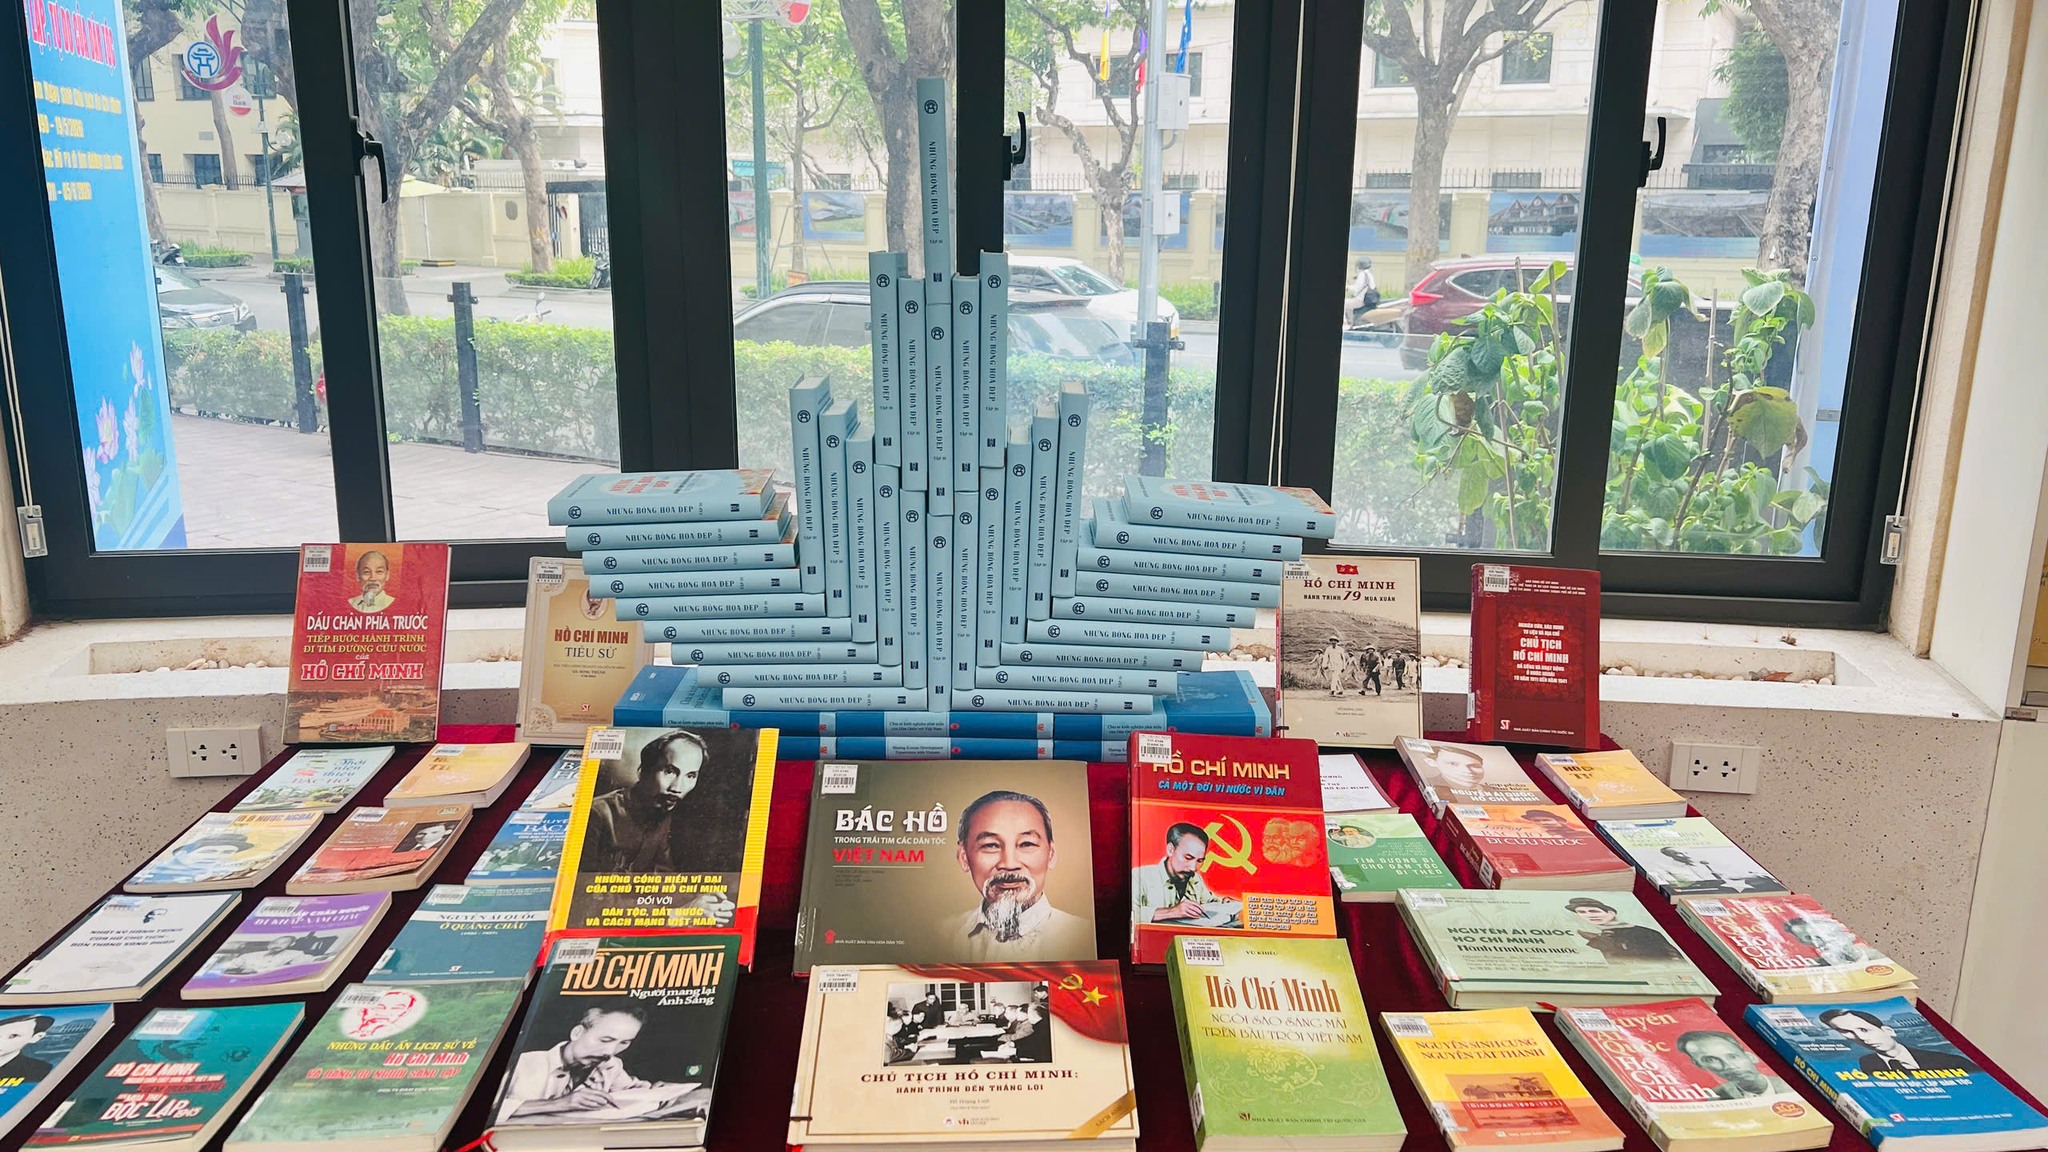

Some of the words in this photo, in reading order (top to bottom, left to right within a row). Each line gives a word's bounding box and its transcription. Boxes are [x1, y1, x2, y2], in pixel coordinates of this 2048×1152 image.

[1238, 517, 1253, 525] HOA
[1304, 577, 1322, 588] HỒ
[1328, 579, 1352, 589] CHÍ
[1357, 581, 1395, 590] MINH
[1343, 591, 1361, 601] 79
[307, 611, 330, 631] DẤU
[332, 612, 363, 631] CHÂN
[365, 612, 390, 630] PHÍA
[392, 608, 428, 630] TRƯỚC
[307, 634, 330, 643] TIẾP
[332, 633, 359, 643] BƯỚC
[362, 634, 390, 643] HÀNH
[393, 634, 424, 642] TRÌNH
[554, 625, 571, 642] HỒ
[573, 628, 595, 643] CHÍ
[596, 631, 628, 645] MINH
[1520, 636, 1539, 648] CHỦ
[1541, 639, 1562, 651] TỊCH
[1513, 649, 1526, 660] HỒ
[1527, 650, 1543, 662] CHÍ
[1545, 652, 1569, 663] MINH
[301, 659, 328, 681] HỒ
[332, 661, 365, 680] CHÍ
[369, 663, 423, 680] MINH
[1191, 756, 1226, 776] CHÍ
[1233, 762, 1290, 779] MINH
[1159, 779, 1169, 789] CẢ
[1173, 782, 1194, 791] MỘT
[1215, 783, 1225, 792] VÌ
[1226, 784, 1251, 794] NƯỚC
[1254, 786, 1263, 794] VÌ
[835, 805, 894, 832] BÁC
[903, 802, 948, 832] HỒ
[834, 836, 861, 844] TRONG
[862, 835, 880, 844] TRÁI
[897, 835, 912, 844] CÁC
[913, 835, 929, 845] DÂN
[930, 835, 947, 846] TỘC
[833, 846, 876, 865] VIỆT
[880, 849, 924, 863] NAM
[594, 875, 630, 884] NHỮNG
[664, 874, 688, 884] HIẾN
[634, 885, 659, 894] TỊCH
[661, 884, 676, 893] HỒ
[679, 883, 697, 893] CHÍ
[700, 885, 728, 893] MINH
[637, 895, 655, 905] ĐỐI
[656, 895, 673, 905] VỚI
[452, 921, 493, 931] QUẢNG
[495, 921, 528, 930] CHÂU
[586, 916, 599, 926] VÀ
[603, 917, 632, 927] CÁCH
[634, 917, 665, 927] MẠNG
[668, 917, 692, 927] VIỆT
[693, 917, 716, 926] NAM
[1751, 957, 1819, 969] Minh
[603, 952, 656, 989] CHÍ
[648, 952, 725, 989] MINH
[629, 988, 667, 1000] Người
[667, 988, 700, 998] mang
[700, 986, 716, 996] lại
[1205, 975, 1237, 1009] Hồ
[1242, 976, 1279, 1011] Chí
[1282, 978, 1342, 1013] Minh
[658, 995, 684, 1006] Ánh
[684, 995, 715, 1006] Sáng
[1212, 1012, 1249, 1024] NGÔI
[1252, 1014, 1282, 1026] SAO
[1285, 1013, 1322, 1028] SÁNG
[1202, 1025, 1237, 1038] TRÊN
[1240, 1025, 1265, 1040] BẦU
[1267, 1027, 1305, 1042] TRỜI
[1308, 1031, 1335, 1044] VIỆT
[1338, 1033, 1363, 1044] NAM
[327, 1041, 367, 1050] NHỮNG
[369, 1039, 394, 1050] DẤU
[395, 1040, 411, 1050] ẤN
[415, 1042, 441, 1051] LỊCH
[461, 1037, 478, 1049] VỀ
[406, 1052, 433, 1065] Chí
[432, 1052, 471, 1065] Minh
[157, 1063, 201, 1076] MINH
[861, 1069, 897, 1083] CHỦ
[904, 1073, 948, 1084] TỊCH
[955, 1068, 980, 1081] HỒ
[986, 1068, 1018, 1080] CHÍ
[1024, 1070, 1080, 1079] MINH:
[1835, 1068, 1862, 1081] HỒ
[1872, 1068, 1909, 1081] CHÍ
[1911, 1067, 1969, 1079] MINH
[1641, 1084, 1721, 1100] Minh
